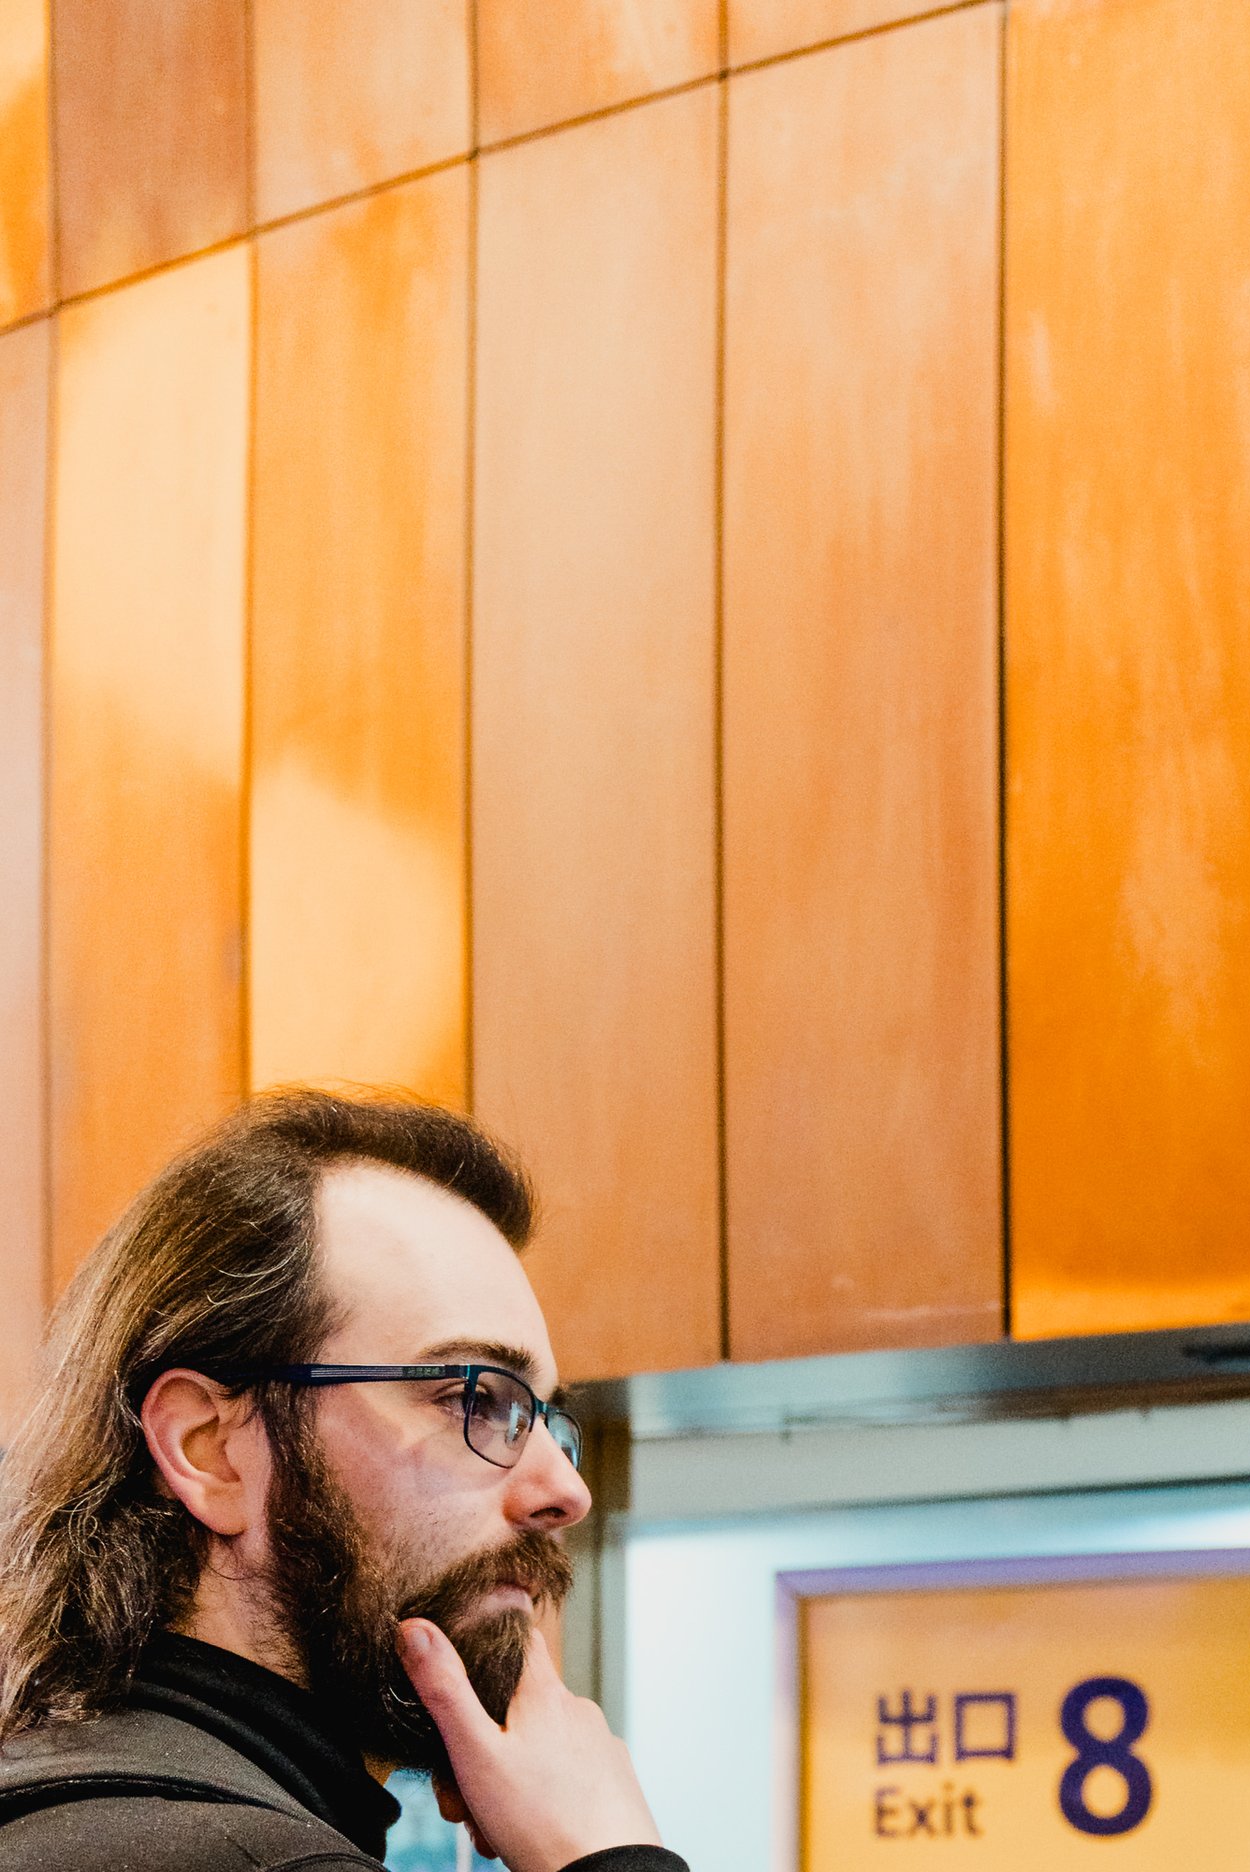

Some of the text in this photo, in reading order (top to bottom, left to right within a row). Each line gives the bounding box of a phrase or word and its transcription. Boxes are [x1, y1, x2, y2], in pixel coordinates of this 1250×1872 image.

[876, 1675, 1153, 1837] 出口 8
[873, 1784, 982, 1838] Exit
